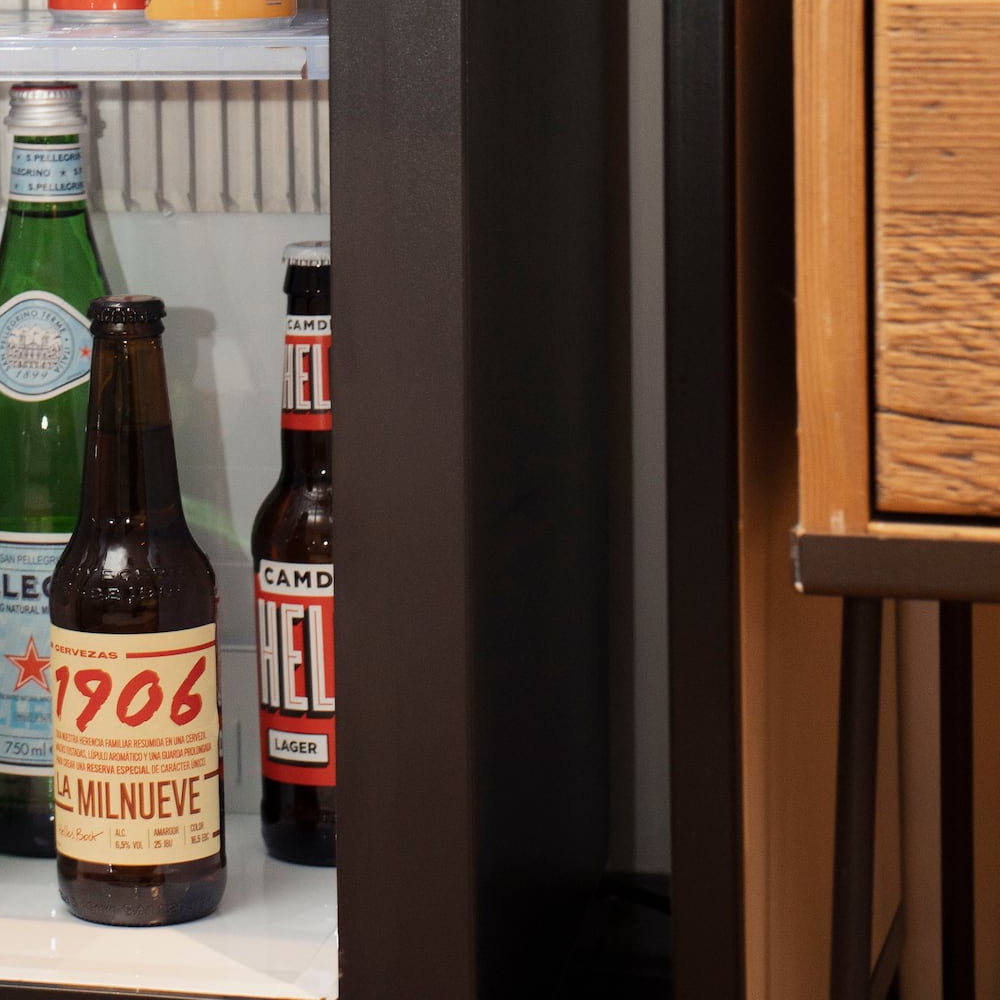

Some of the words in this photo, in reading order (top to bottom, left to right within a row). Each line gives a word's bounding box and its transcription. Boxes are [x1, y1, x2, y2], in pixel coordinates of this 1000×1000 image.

[42, 311, 66, 333] TERME
[287, 320, 328, 330] CAMD
[264, 567, 333, 589] CAMD
[6, 604, 39, 615] NATURAL
[55, 644, 119, 660] CERVEZAS
[258, 598, 335, 712] HEL
[55, 655, 207, 733] 1906
[79, 735, 105, 747] HERENCIA
[105, 738, 133, 748] FAMILIAR
[133, 737, 164, 748] RESUMIDA
[165, 736, 173, 746] EN
[174, 735, 185, 745] UNA
[274, 737, 317, 755] LAGER
[109, 749, 143, 761] AROMÁTICO
[144, 751, 149, 761] Y
[150, 750, 161, 760] UNA
[161, 747, 183, 760] GUARDA
[87, 763, 115, 774] RESERVA
[116, 764, 150, 775] ESPECIAL
[152, 764, 160, 774] DE
[161, 760, 190, 773] CARÁCTER
[56, 772, 72, 799] LA
[77, 776, 201, 820] MILNUEVE
[153, 826, 179, 836] AMARGOR
[190, 822, 204, 832] COLOR
[133, 841, 144, 849] VOL
[153, 840, 162, 849] 25
